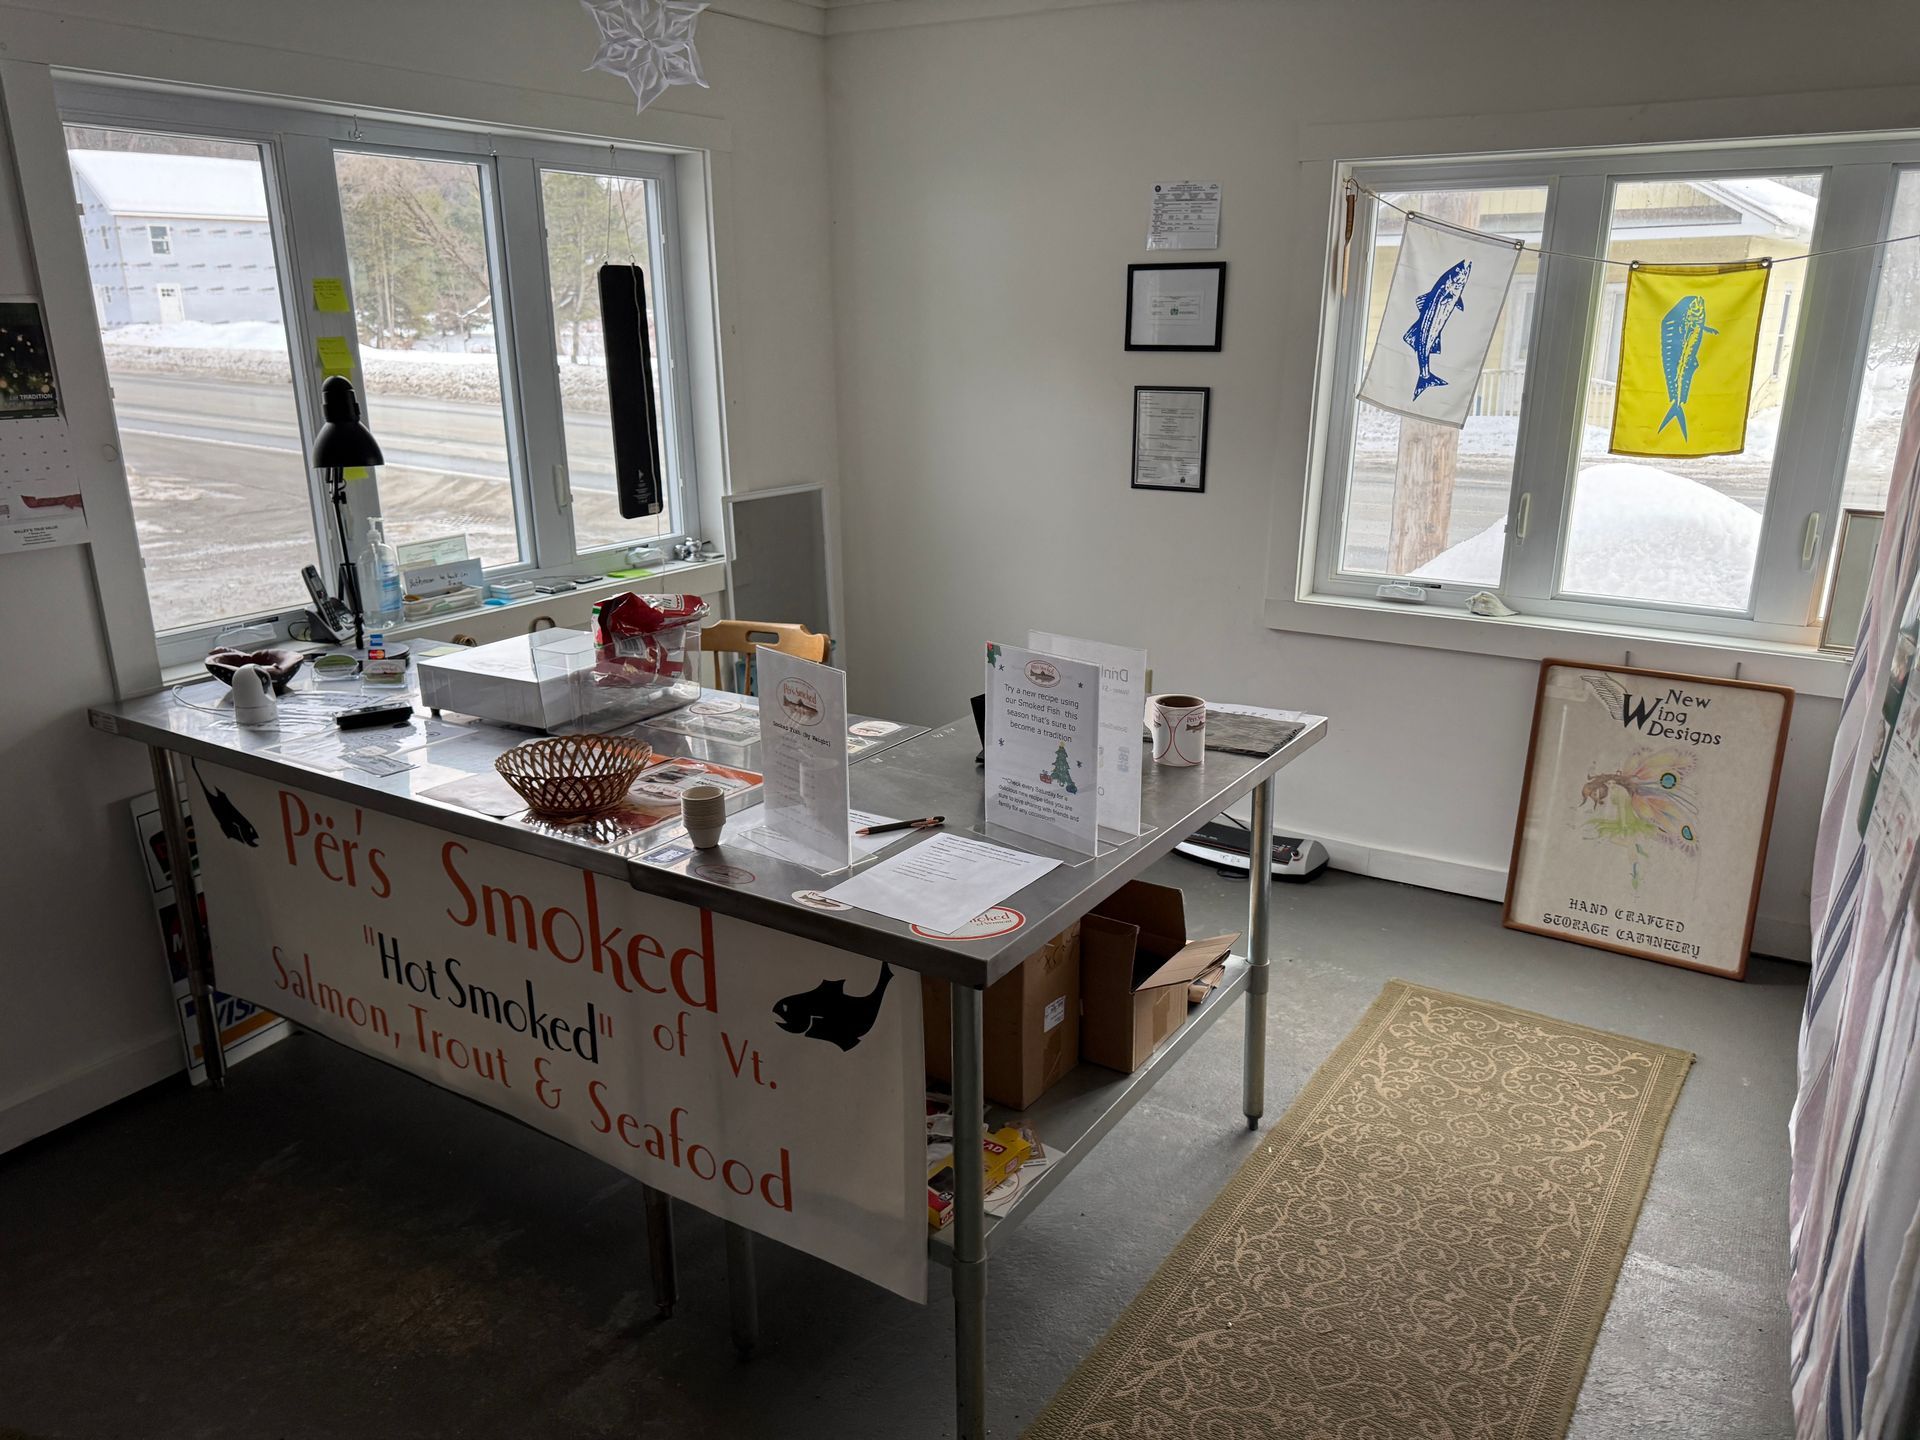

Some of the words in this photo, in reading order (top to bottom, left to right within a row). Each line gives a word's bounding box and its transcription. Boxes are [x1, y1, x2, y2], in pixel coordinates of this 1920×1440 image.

[1004, 684, 1014, 694] Try
[1022, 689, 1036, 697] new
[1038, 692, 1058, 703] recipe
[1060, 698, 1079, 710] using
[1018, 698, 1045, 712] Smoked
[1046, 706, 1060, 715] Fish
[1064, 710, 1078, 720] this
[1666, 688, 1712, 710] New
[1007, 708, 1030, 720] season
[1031, 714, 1050, 726] that's
[1052, 720, 1066, 730] sure
[1068, 724, 1076, 732] to
[1622, 694, 1687, 731] Wing
[1010, 720, 1036, 734] become
[1043, 729, 1072, 742] tradition
[1646, 720, 1722, 746] Designs
[442, 841, 718, 1014] Smoked
[1568, 898, 1608, 917] HAND
[1614, 908, 1686, 933] CRAFTED
[1542, 912, 1609, 937] STORAGE
[1616, 928, 1700, 959] CABINETRY
[652, 1011, 691, 1057] of
[721, 1032, 777, 1090] Vt.
[272, 946, 401, 1049] Salmon,
[408, 1003, 512, 1088] Trout
[534, 1056, 562, 1110] &
[588, 1080, 793, 1213] Seafood
